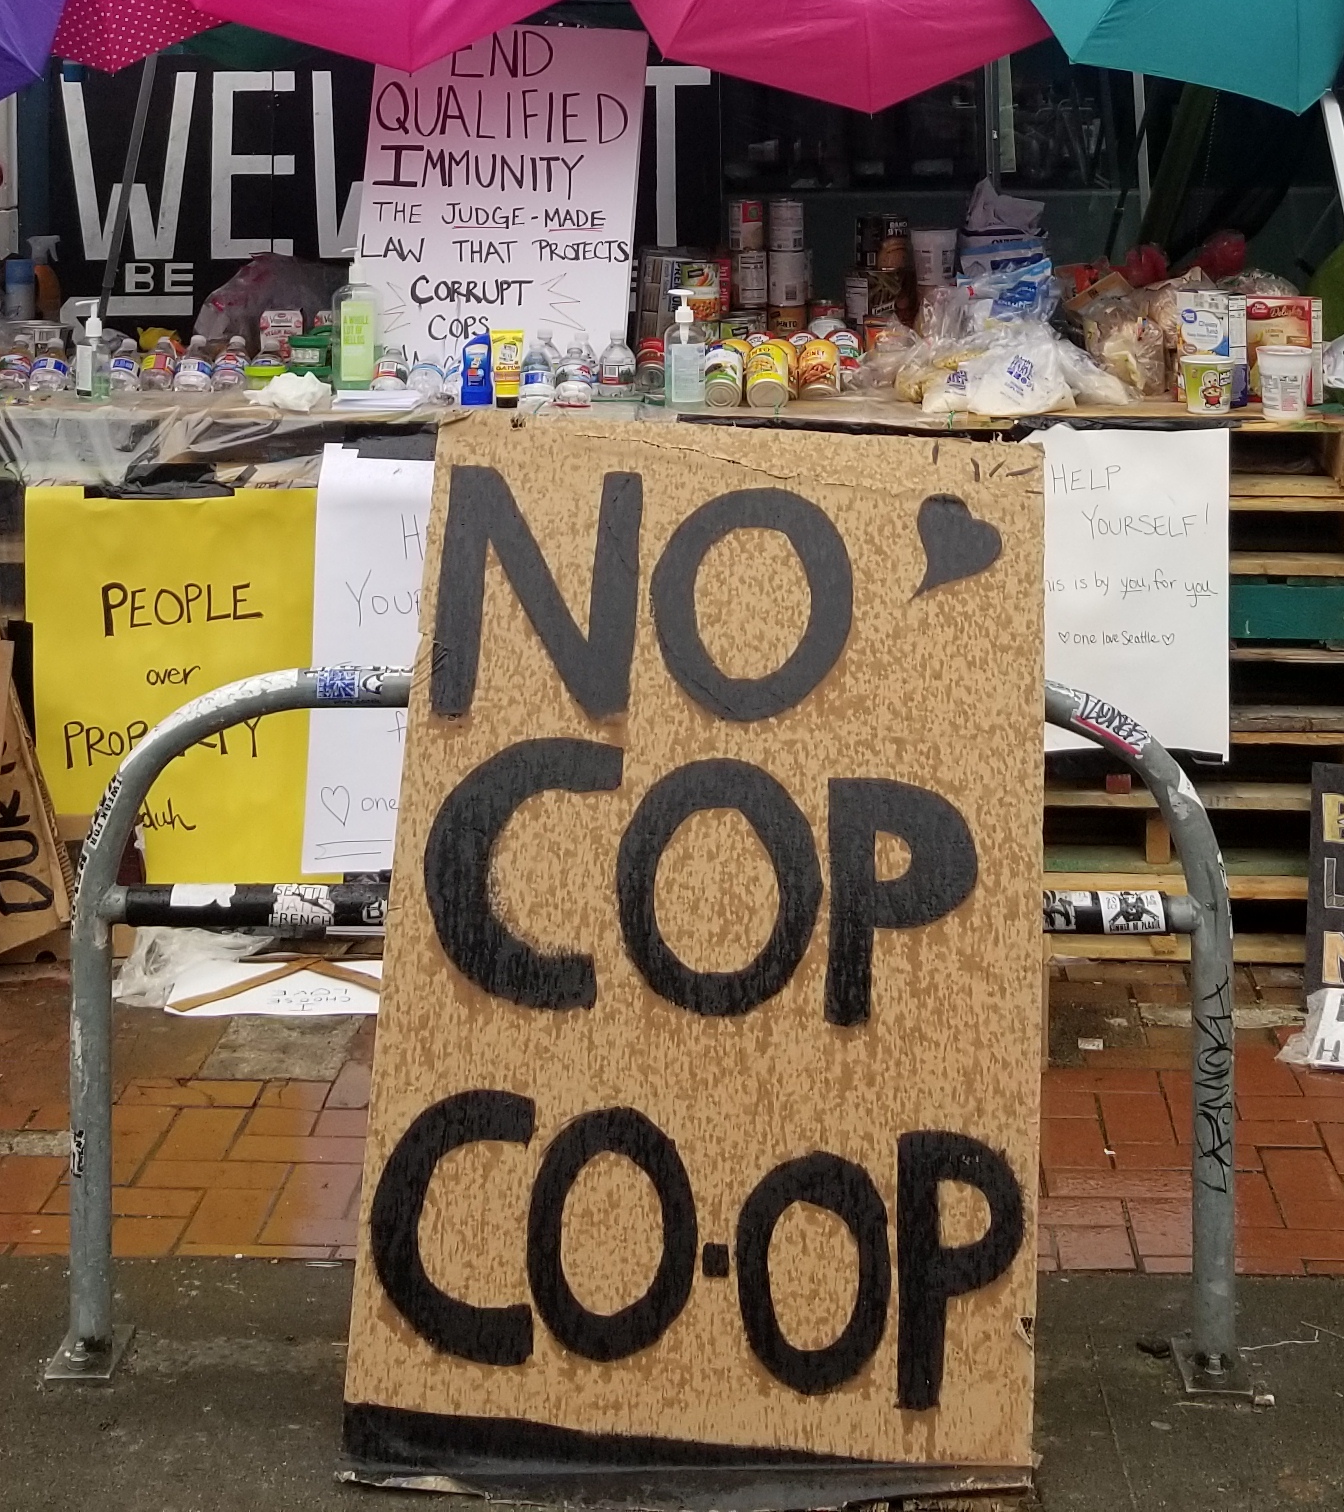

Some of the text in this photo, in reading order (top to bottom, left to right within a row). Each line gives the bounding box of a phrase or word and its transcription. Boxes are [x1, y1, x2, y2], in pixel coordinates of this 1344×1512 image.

[452, 27, 554, 79] END
[375, 83, 630, 145] QUALIFIED
[372, 144, 585, 197] IMMUNITY
[373, 201, 607, 231] THE JUDGE-MADE
[360, 236, 632, 265] LAW THAT PROTECTS
[124, 262, 195, 293] BE
[410, 275, 535, 307] CORRUPT
[427, 314, 491, 342] COPS
[1050, 464, 1122, 495] HELP
[1081, 503, 1211, 540] YOURSELF!
[431, 465, 854, 721] NO
[1074, 576, 1092, 591] is
[1094, 572, 1110, 597] by
[1152, 568, 1178, 591] for
[1184, 579, 1220, 608] you
[101, 581, 264, 638] PEOPLE
[1073, 629, 1161, 646] one love Seattle
[146, 663, 203, 686] over
[142, 796, 197, 832] duh
[423, 735, 979, 1027] COP
[270, 912, 333, 926] FRENCH
